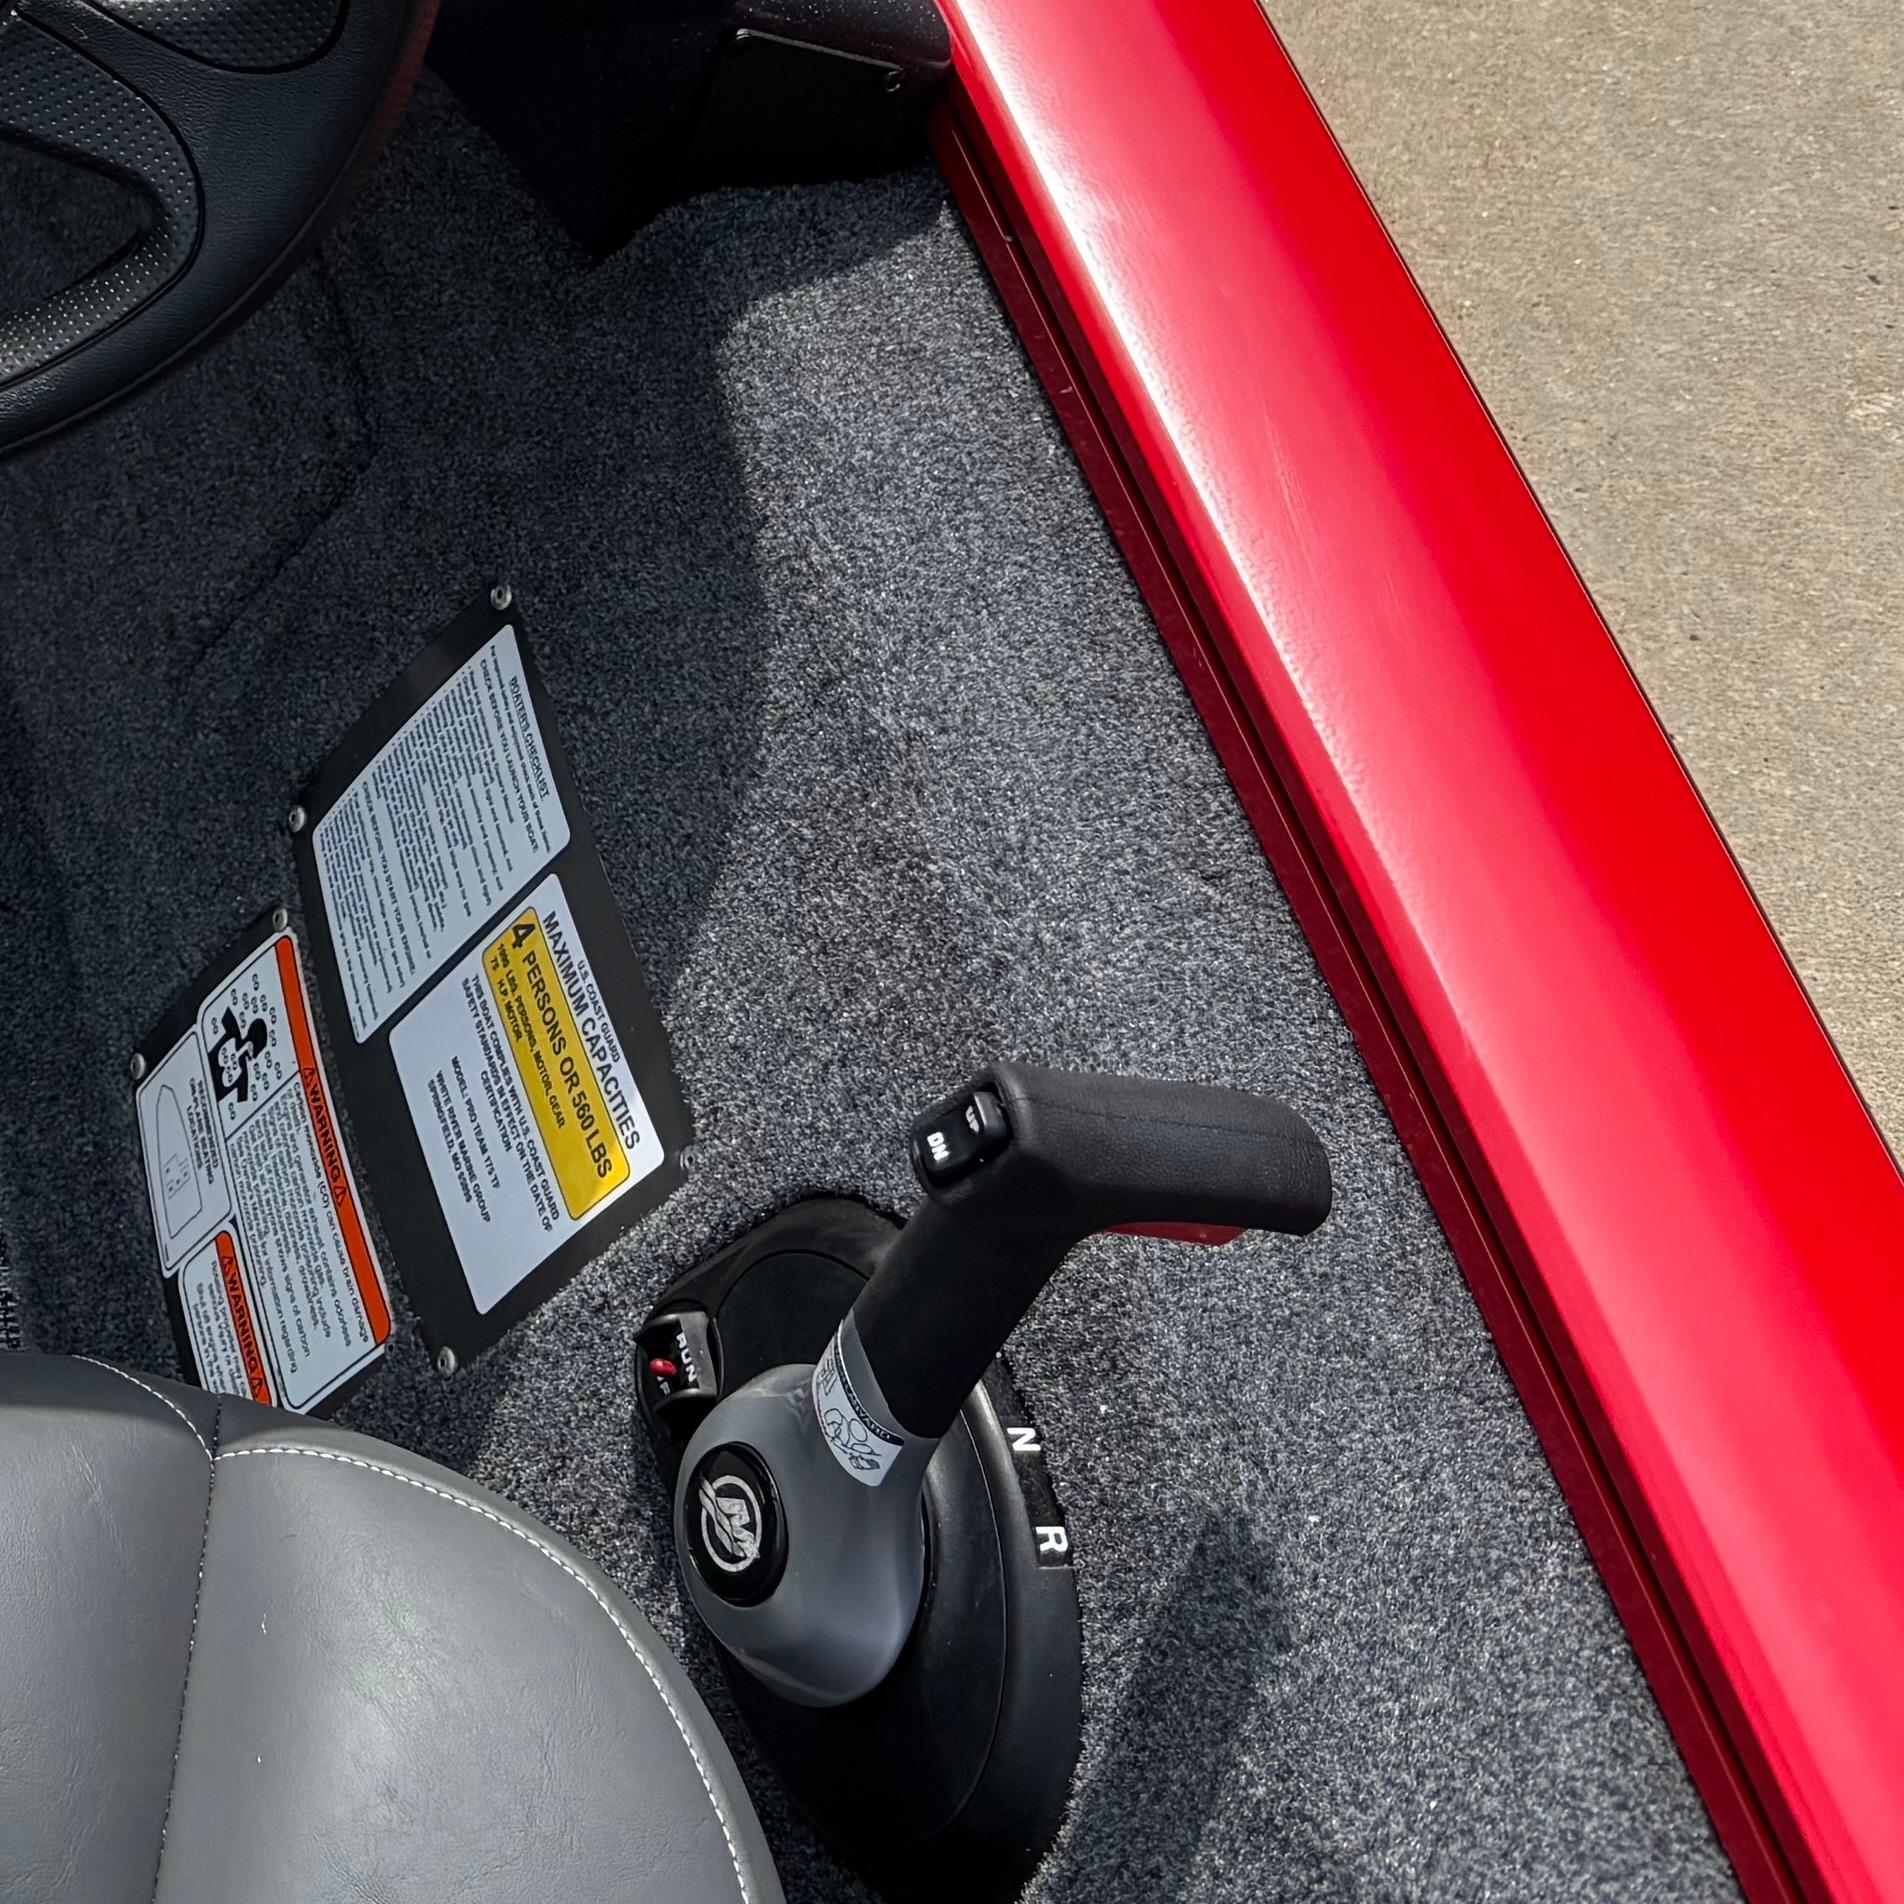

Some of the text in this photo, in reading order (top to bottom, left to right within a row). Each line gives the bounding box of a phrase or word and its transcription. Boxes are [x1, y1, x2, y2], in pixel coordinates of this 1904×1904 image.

[524, 729, 549, 802] CHECKLIST
[503, 999, 523, 1042] MOTOR
[506, 910, 613, 1181] 4 PERSONS OR 560 LBS
[541, 909, 642, 1154] MAXIMUM CAPACITIES
[576, 958, 621, 1065] U.S. COAST GUARD
[307, 1081, 342, 1185] WARNING
[460, 976, 481, 1021] SAFETY
[473, 1018, 502, 1087] STANDARDS
[500, 1096, 521, 1143] EFFECT
[514, 1139, 527, 1161] ON
[521, 1158, 535, 1185] THE
[529, 1182, 546, 1217] DATE
[540, 1214, 553, 1235] OF
[463, 1096, 478, 1125] PRO
[472, 1121, 488, 1157] TEAM
[470, 973, 560, 1222] THIS BOAT COMPLIES WITH U.S. COAST GUARD
[478, 1068, 513, 1154] CERTIFICATION
[548, 1092, 566, 1130] GEAR
[290, 1169, 304, 1209] carbon
[434, 1069, 452, 1107] WHITE
[446, 1104, 463, 1141] RIVER
[457, 1138, 477, 1185] MARINE
[471, 1181, 491, 1226] GROUP
[265, 1105, 332, 1340] Signs of carbon monoxide poisoning include
[274, 1235, 288, 1274] shows
[277, 1093, 352, 1349] Engine and generator exhaust contains odorless
[293, 1080, 369, 1346] Carbon monoxide (CO) can cause brain damage
[226, 1273, 259, 1373] WARNING
[264, 1256, 284, 1320] information
[278, 1317, 299, 1376] regarding
[283, 1272, 297, 1306] signs
[292, 1302, 300, 1318] of
[295, 1315, 311, 1359] carbon
[676, 1332, 698, 1383] RUN
[1006, 1427, 1042, 1452] N
[1035, 1526, 1069, 1553] R
